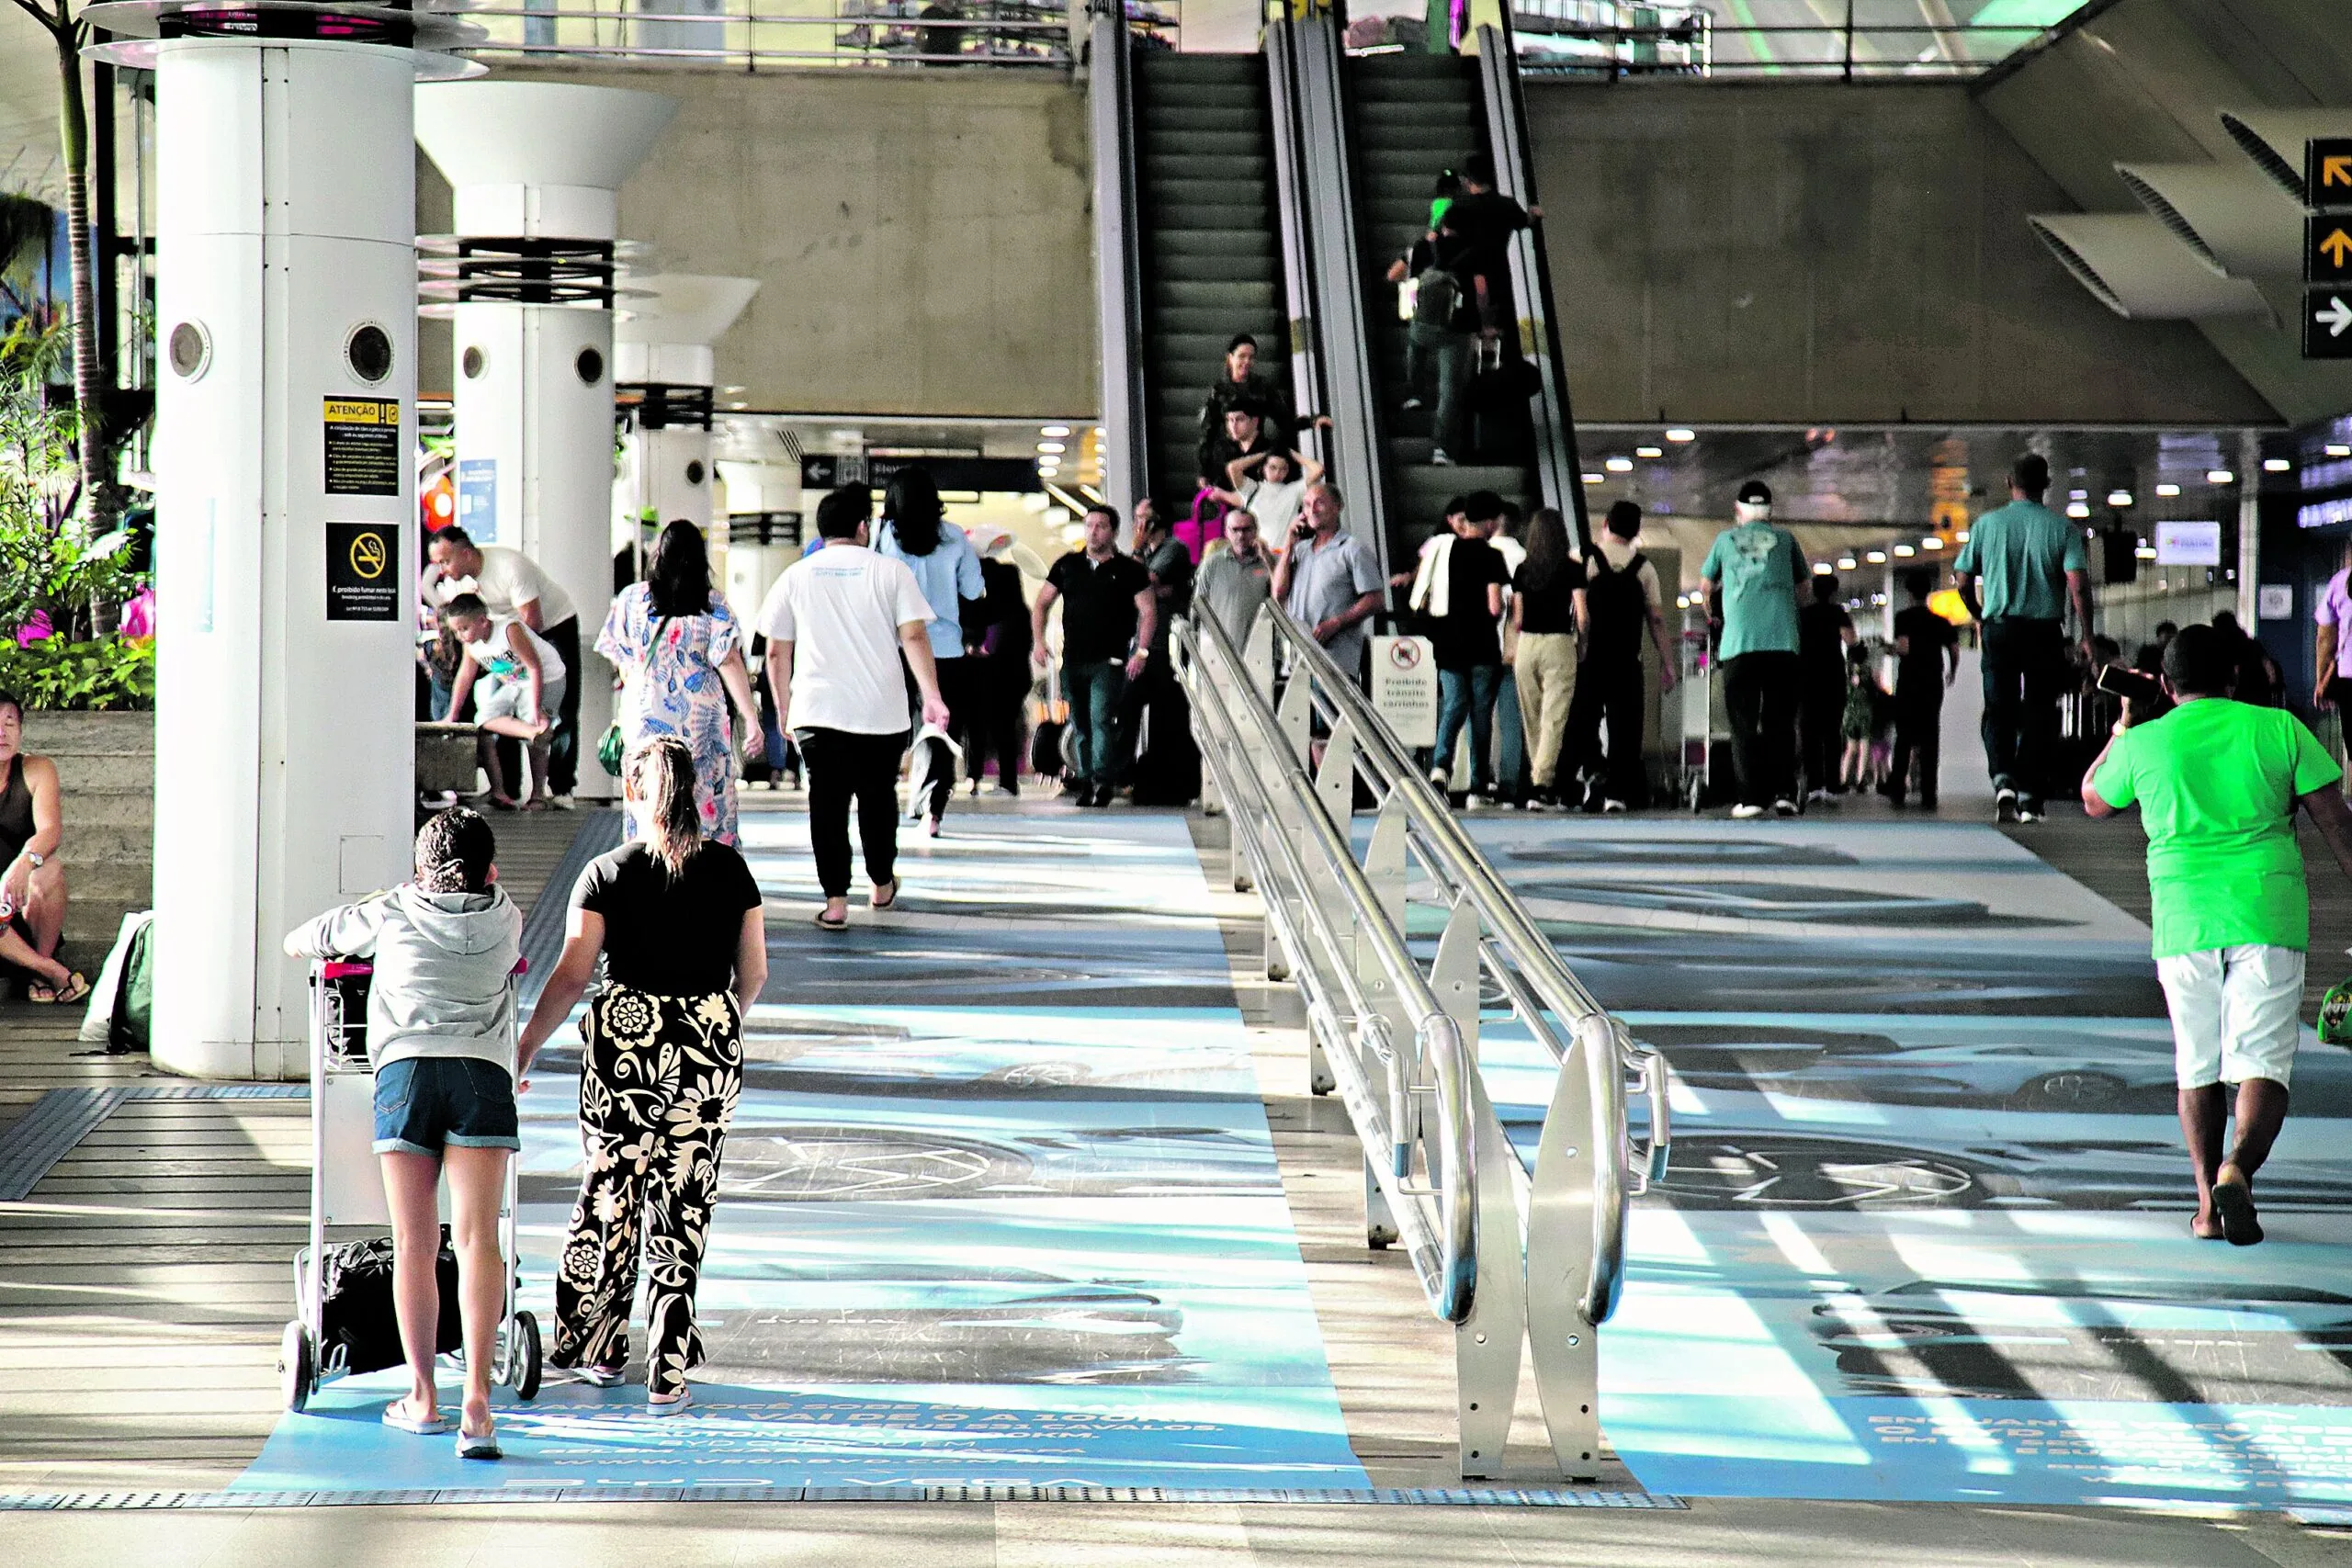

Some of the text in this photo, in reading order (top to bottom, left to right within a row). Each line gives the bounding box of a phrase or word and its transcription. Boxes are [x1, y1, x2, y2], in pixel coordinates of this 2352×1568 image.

[329, 404, 376, 416] ATENÇÃO
[1385, 677, 1427, 686] Proibido
[747, 1413, 834, 1421] VAI
[846, 1413, 921, 1421] DE
[1881, 1436, 1936, 1444] EM
[503, 1478, 1102, 1487] BYD VEGA
